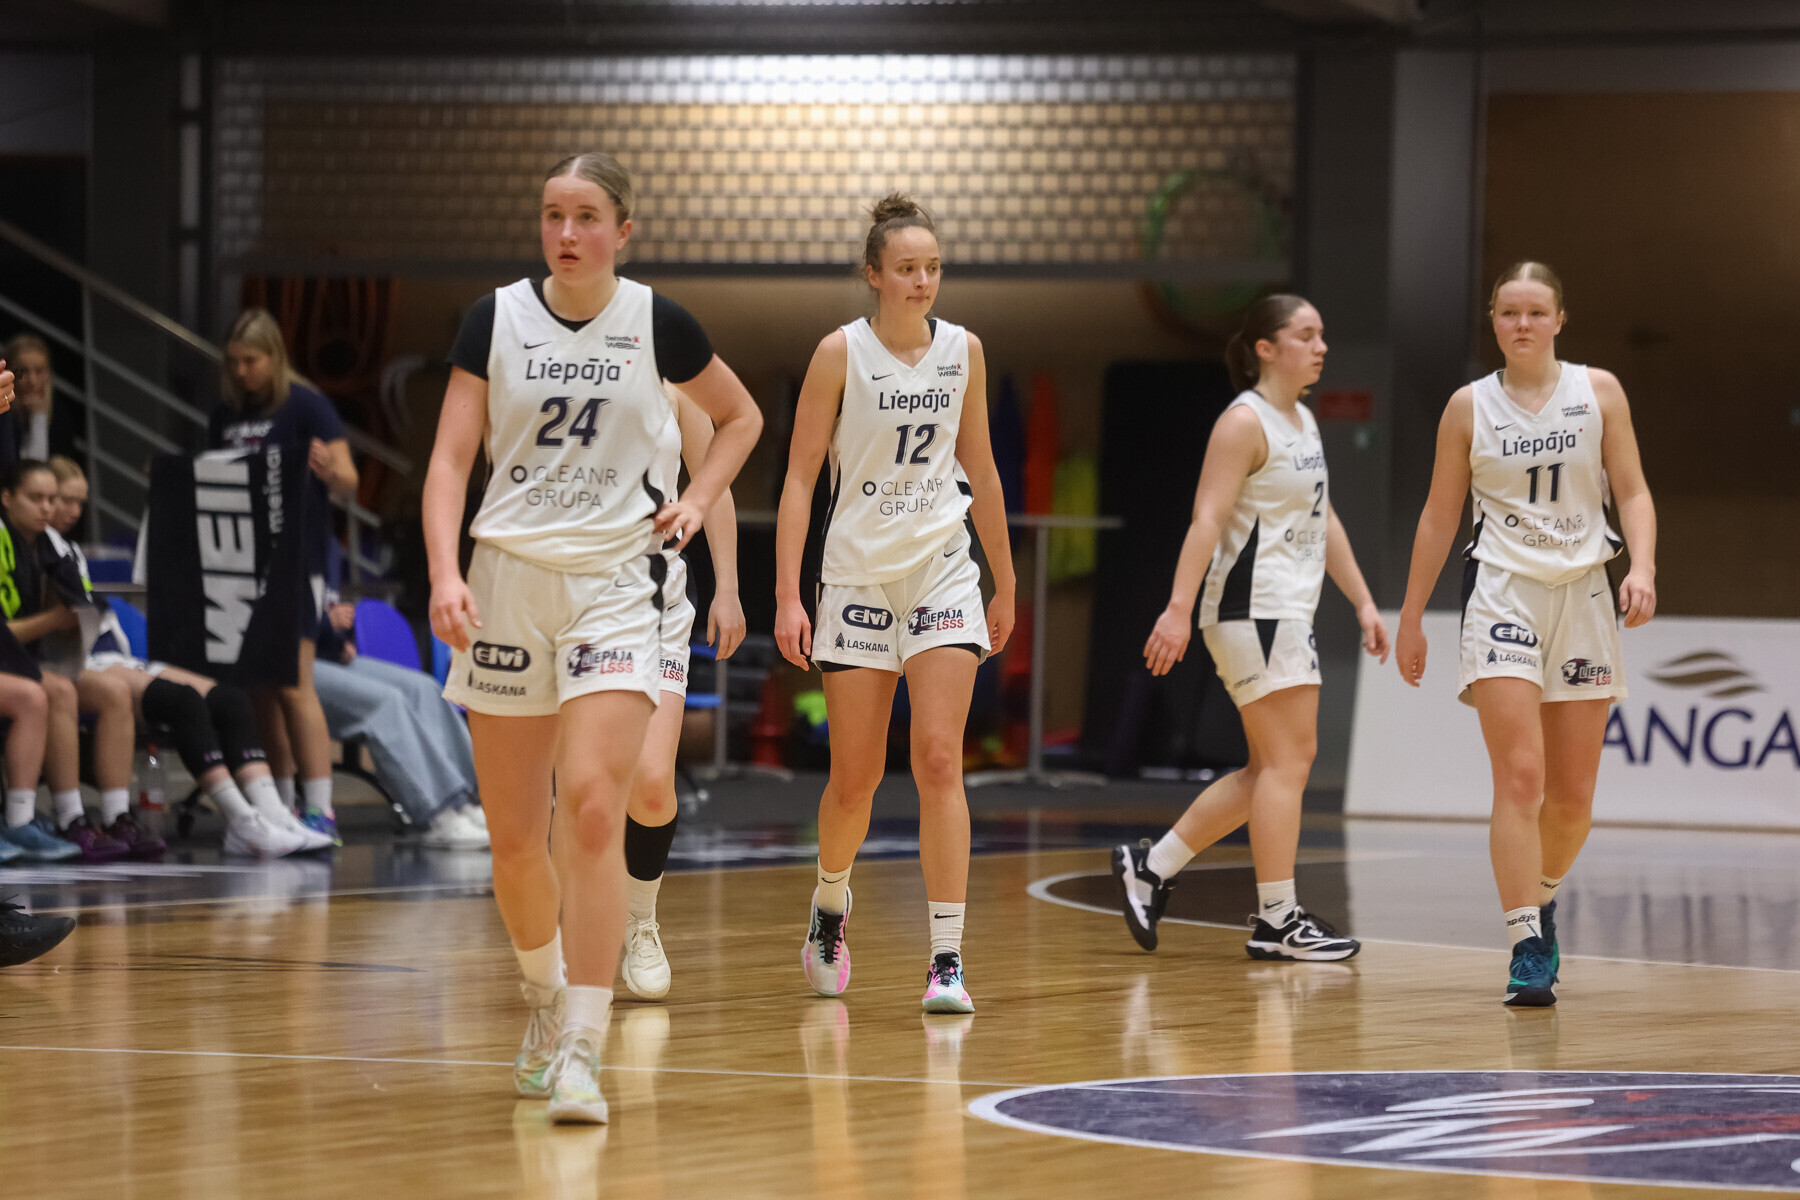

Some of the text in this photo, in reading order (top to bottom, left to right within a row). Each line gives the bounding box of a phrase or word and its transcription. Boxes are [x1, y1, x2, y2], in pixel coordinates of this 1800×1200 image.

[525, 357, 621, 385] Liepāja
[878, 388, 950, 414] Liepāja
[535, 396, 612, 449] 24
[895, 423, 940, 466] 12
[1502, 430, 1577, 457] Liepāja
[532, 464, 620, 488] CLEANR
[881, 477, 943, 496] CLEANR
[1526, 462, 1566, 505] 11
[525, 488, 603, 511] GRUPA
[848, 608, 888, 627] Elvi
[936, 618, 964, 631] LSSS
[474, 645, 524, 668] Elvi
[847, 639, 889, 653] LASKANA
[600, 661, 634, 675] LSSS
[663, 668, 684, 683] LSSS
[474, 681, 527, 697] ASKANA
[1602, 704, 1800, 771] ANGA
